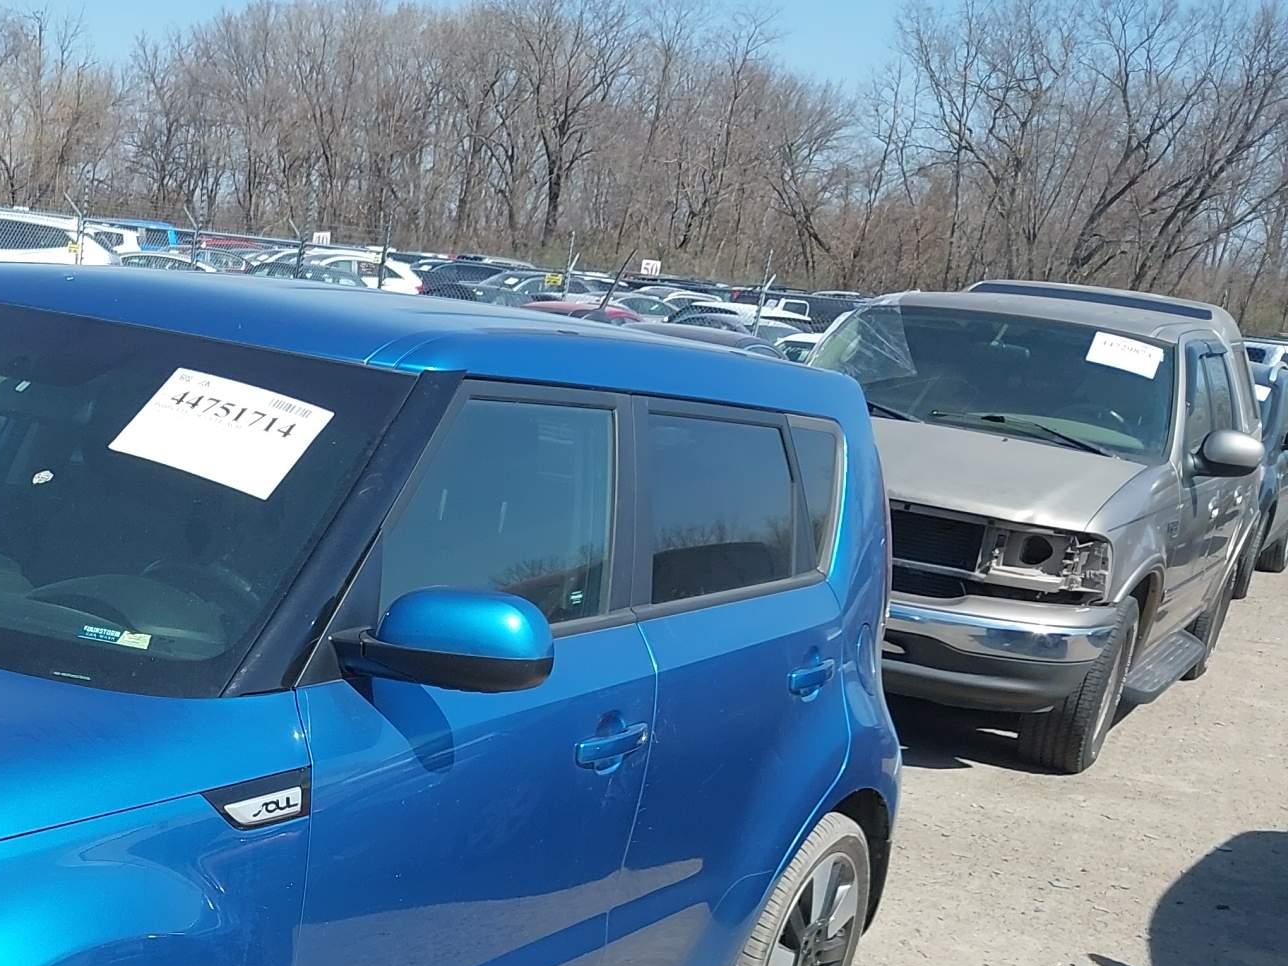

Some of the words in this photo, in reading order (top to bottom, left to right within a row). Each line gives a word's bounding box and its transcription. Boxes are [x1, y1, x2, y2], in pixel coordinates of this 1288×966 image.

[643, 262, 658, 275] 50
[171, 391, 296, 438] 44751714
[252, 797, 299, 817] SOUL
